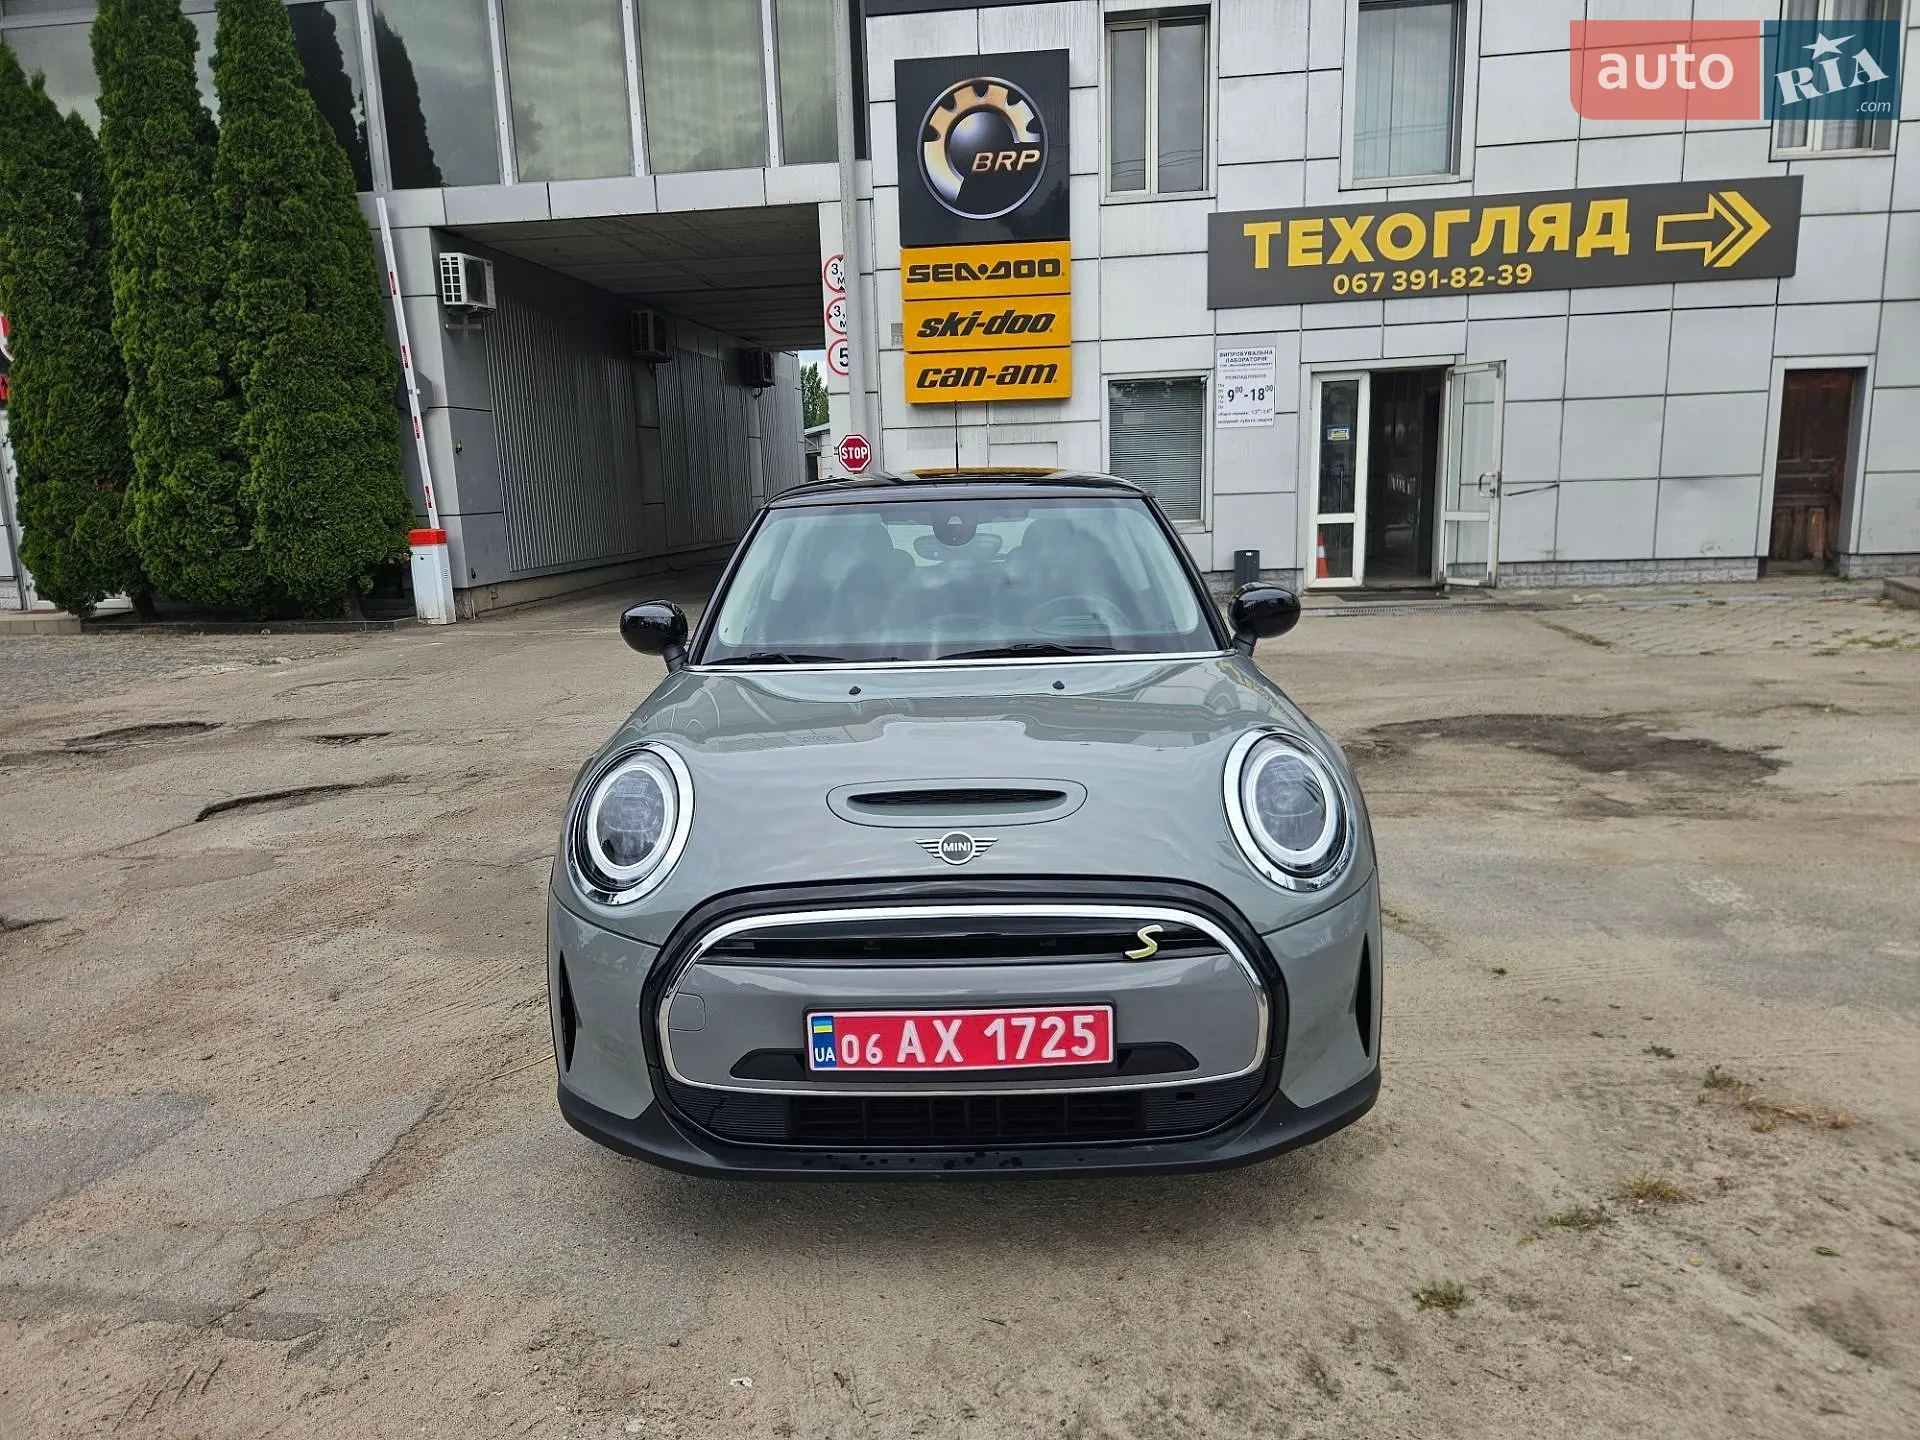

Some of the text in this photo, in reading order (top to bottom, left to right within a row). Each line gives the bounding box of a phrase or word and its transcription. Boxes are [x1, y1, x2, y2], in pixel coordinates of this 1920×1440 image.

[970, 149, 1041, 173] BRP
[1242, 198, 1630, 269] ТЕХОГЛЯД
[1331, 263, 1532, 295] 067 391-82-39
[916, 308, 1056, 338] ski-doo
[915, 361, 1058, 389] can-am
[841, 446, 868, 460] STOP
[943, 841, 971, 852] MINI
[1123, 924, 1164, 960] S
[814, 1014, 1096, 1065] UA 06 AX 1725
